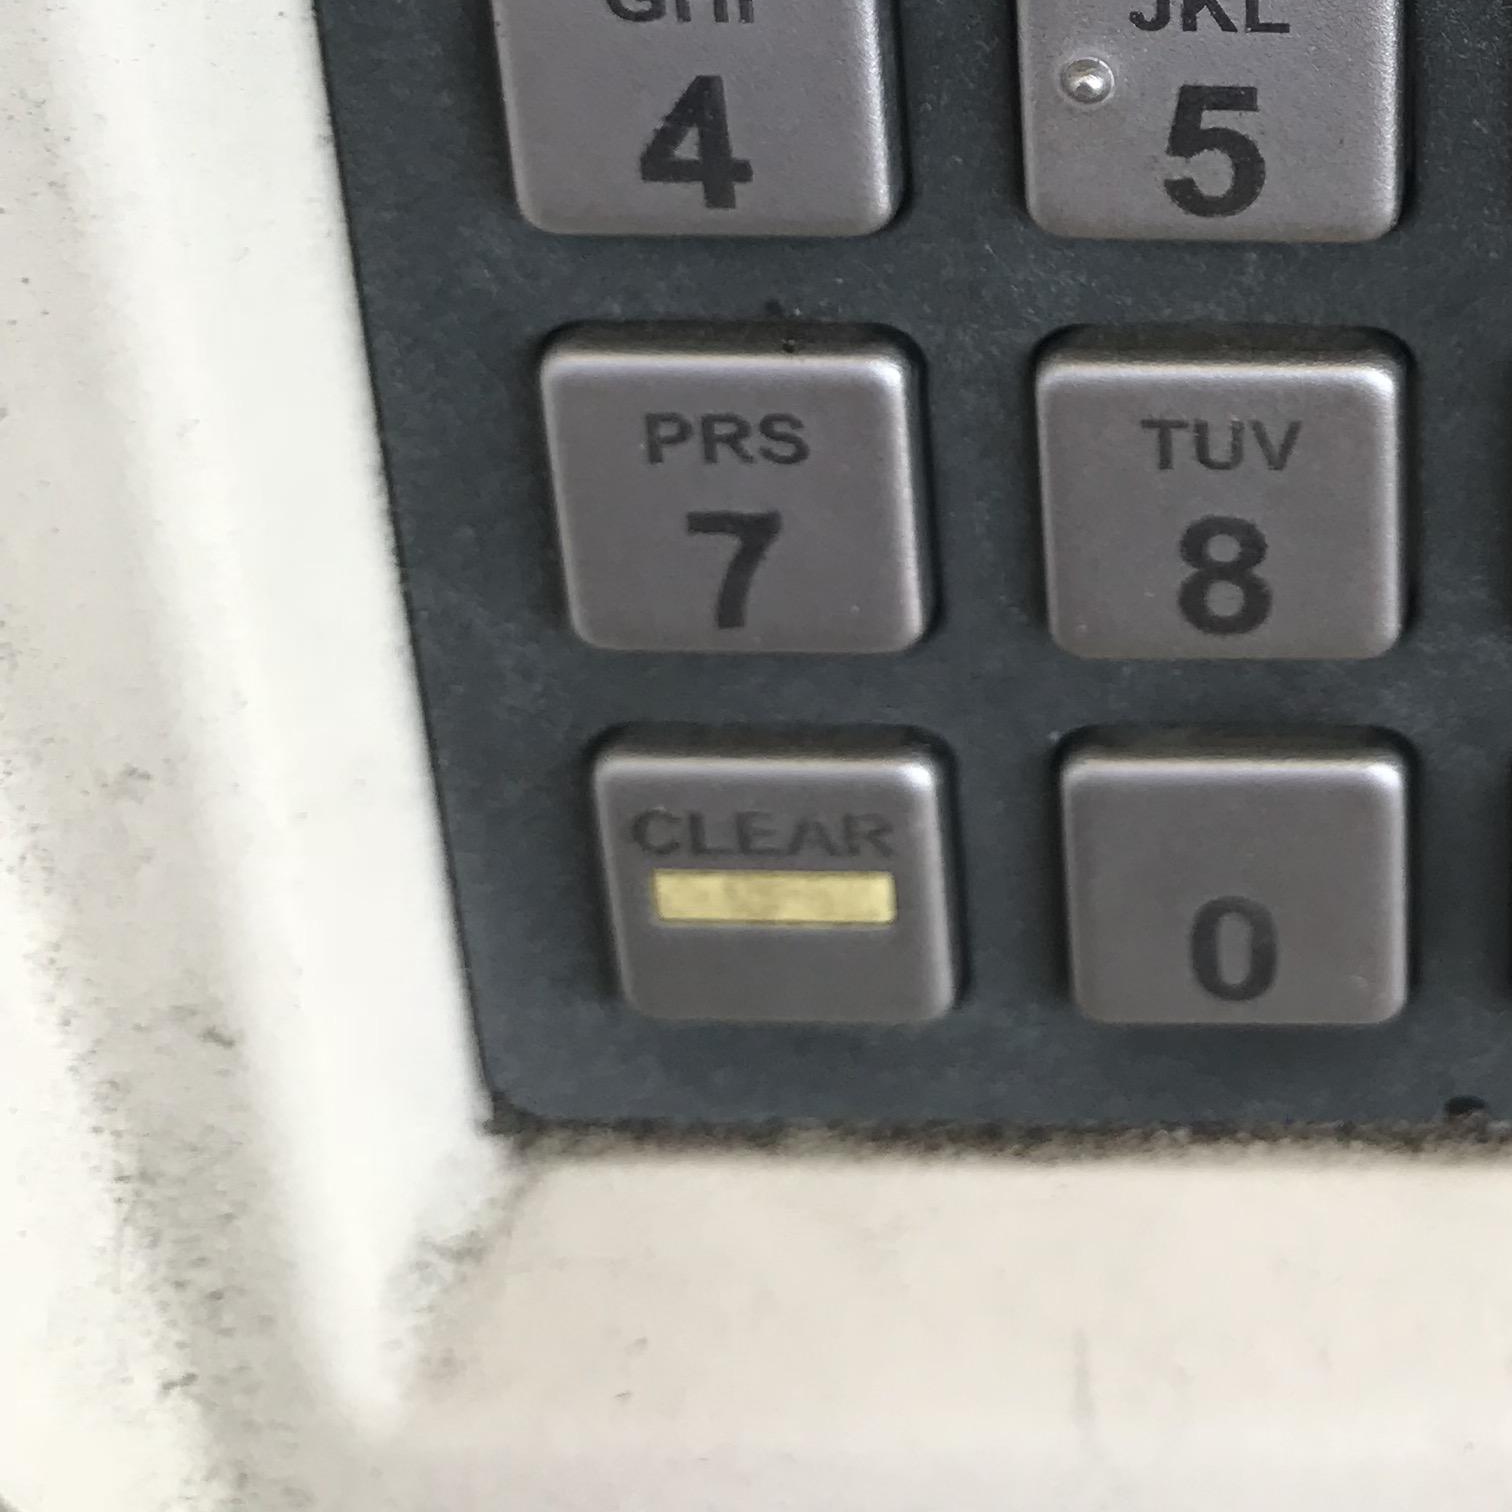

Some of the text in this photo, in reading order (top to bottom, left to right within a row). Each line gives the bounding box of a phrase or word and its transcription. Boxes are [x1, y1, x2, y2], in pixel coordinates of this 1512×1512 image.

[639, 75, 753, 209] 4
[1164, 84, 1265, 217] 5
[644, 413, 809, 465] PRS
[1139, 418, 1302, 471] TUV
[686, 511, 781, 630] 7
[1178, 517, 1271, 636] 8
[628, 811, 896, 858] CLEAR
[1191, 898, 1277, 1001] 0
